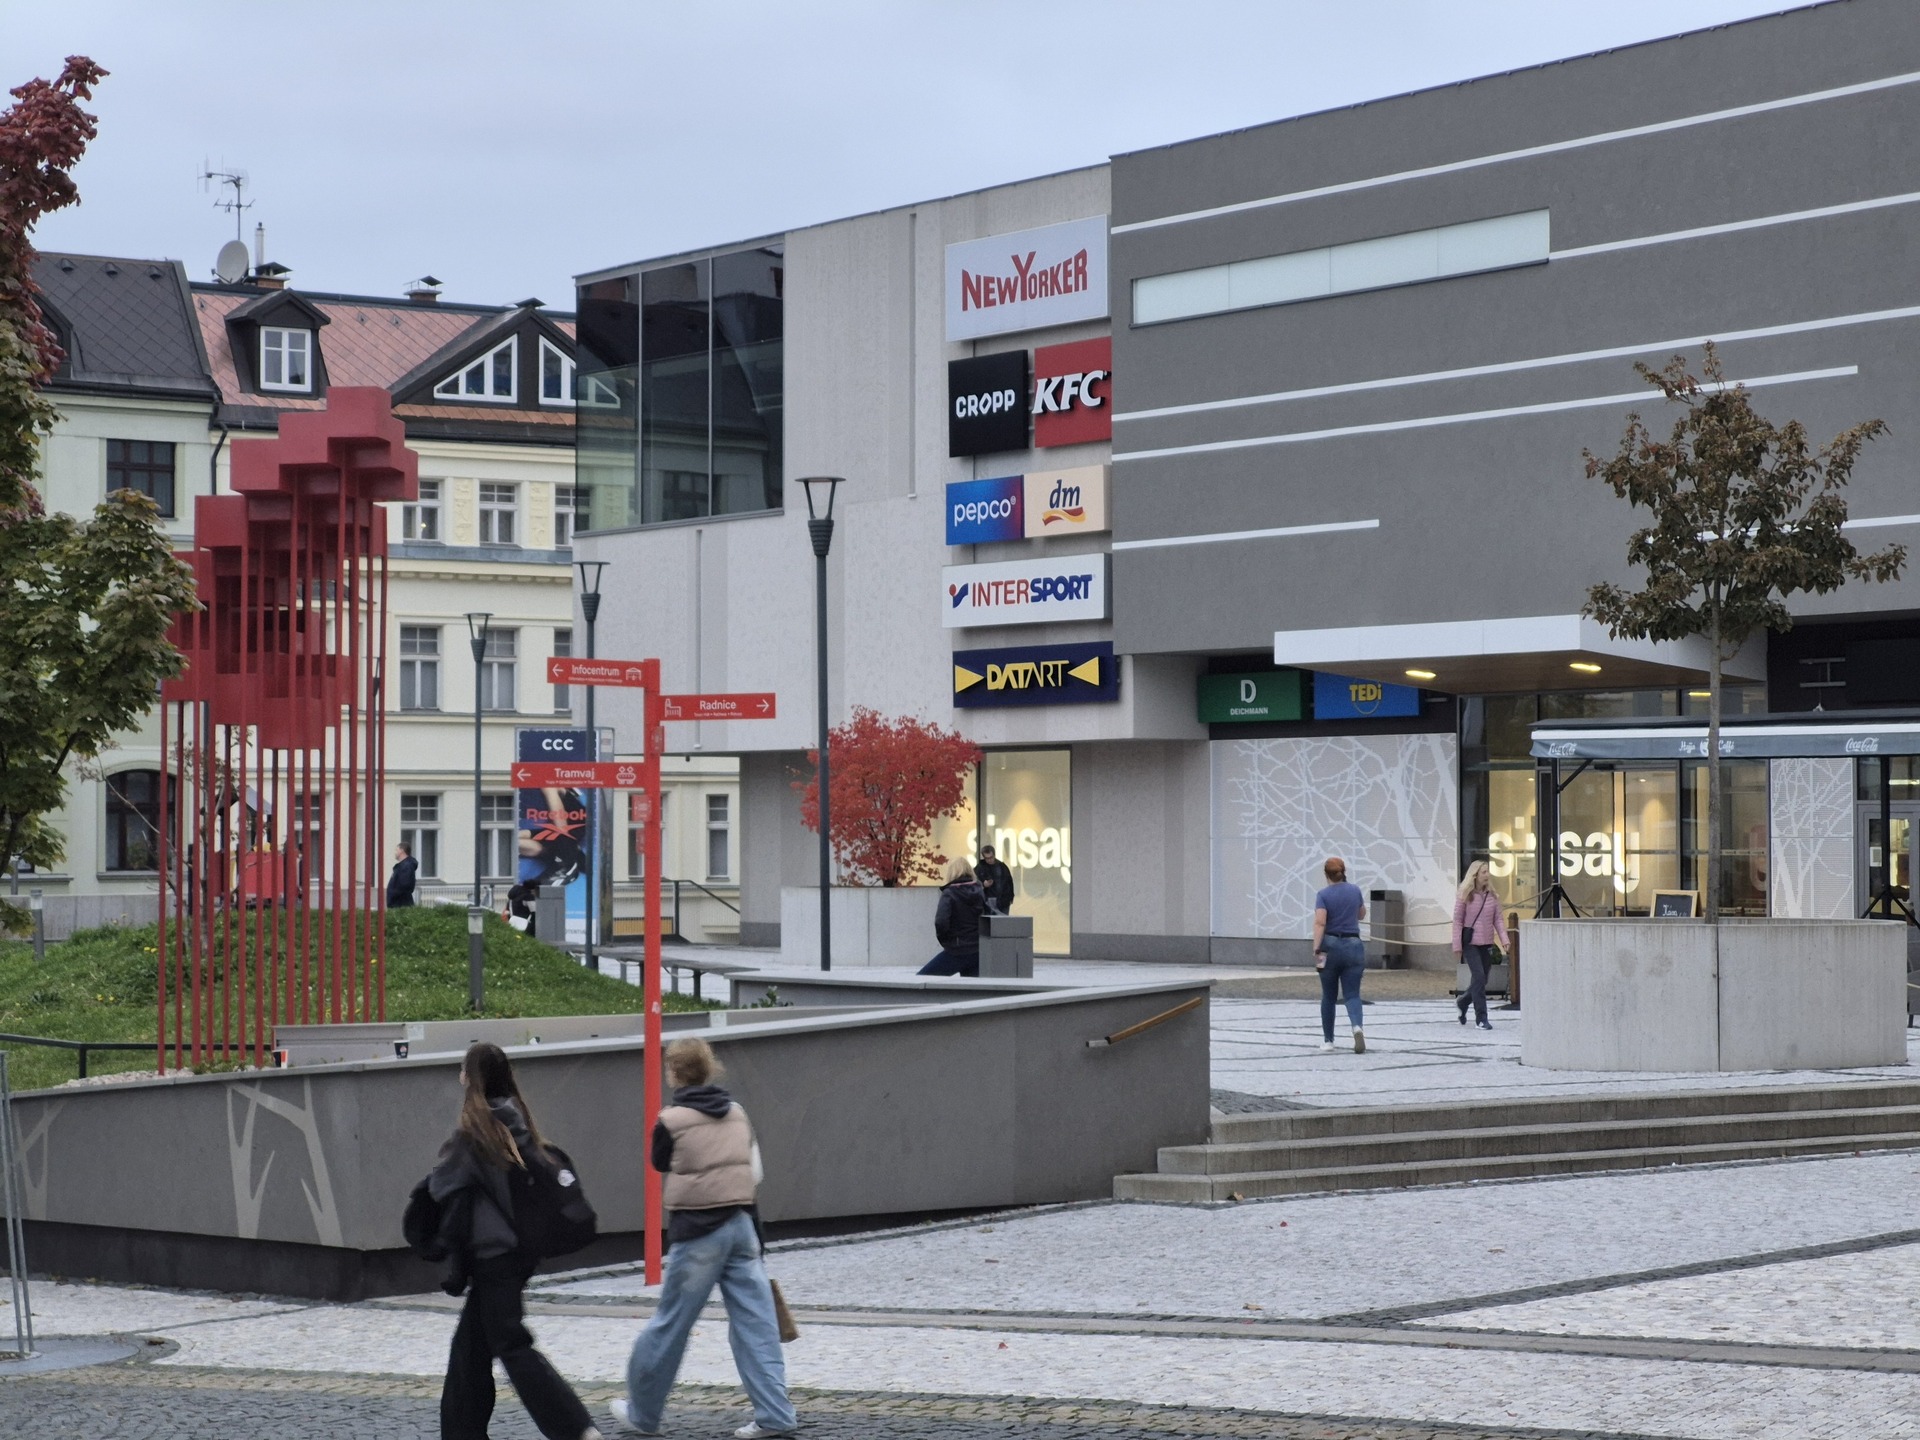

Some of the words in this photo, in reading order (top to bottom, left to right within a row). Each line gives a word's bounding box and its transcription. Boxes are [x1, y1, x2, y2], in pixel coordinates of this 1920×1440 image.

[955, 389, 1015, 418] CROPP
[1032, 370, 1104, 415] KFC
[1049, 479, 1080, 509] dm
[972, 574, 1093, 607] INTERSPORT
[571, 664, 620, 677] Infocentrum
[986, 660, 1069, 690] DATART
[699, 700, 737, 710] Radnice
[1240, 679, 1257, 703] D
[1230, 707, 1268, 716] DEICHMANN
[553, 768, 595, 780] Tramvaj
[966, 813, 1072, 884] snsay
[1488, 816, 1640, 894] ssay
